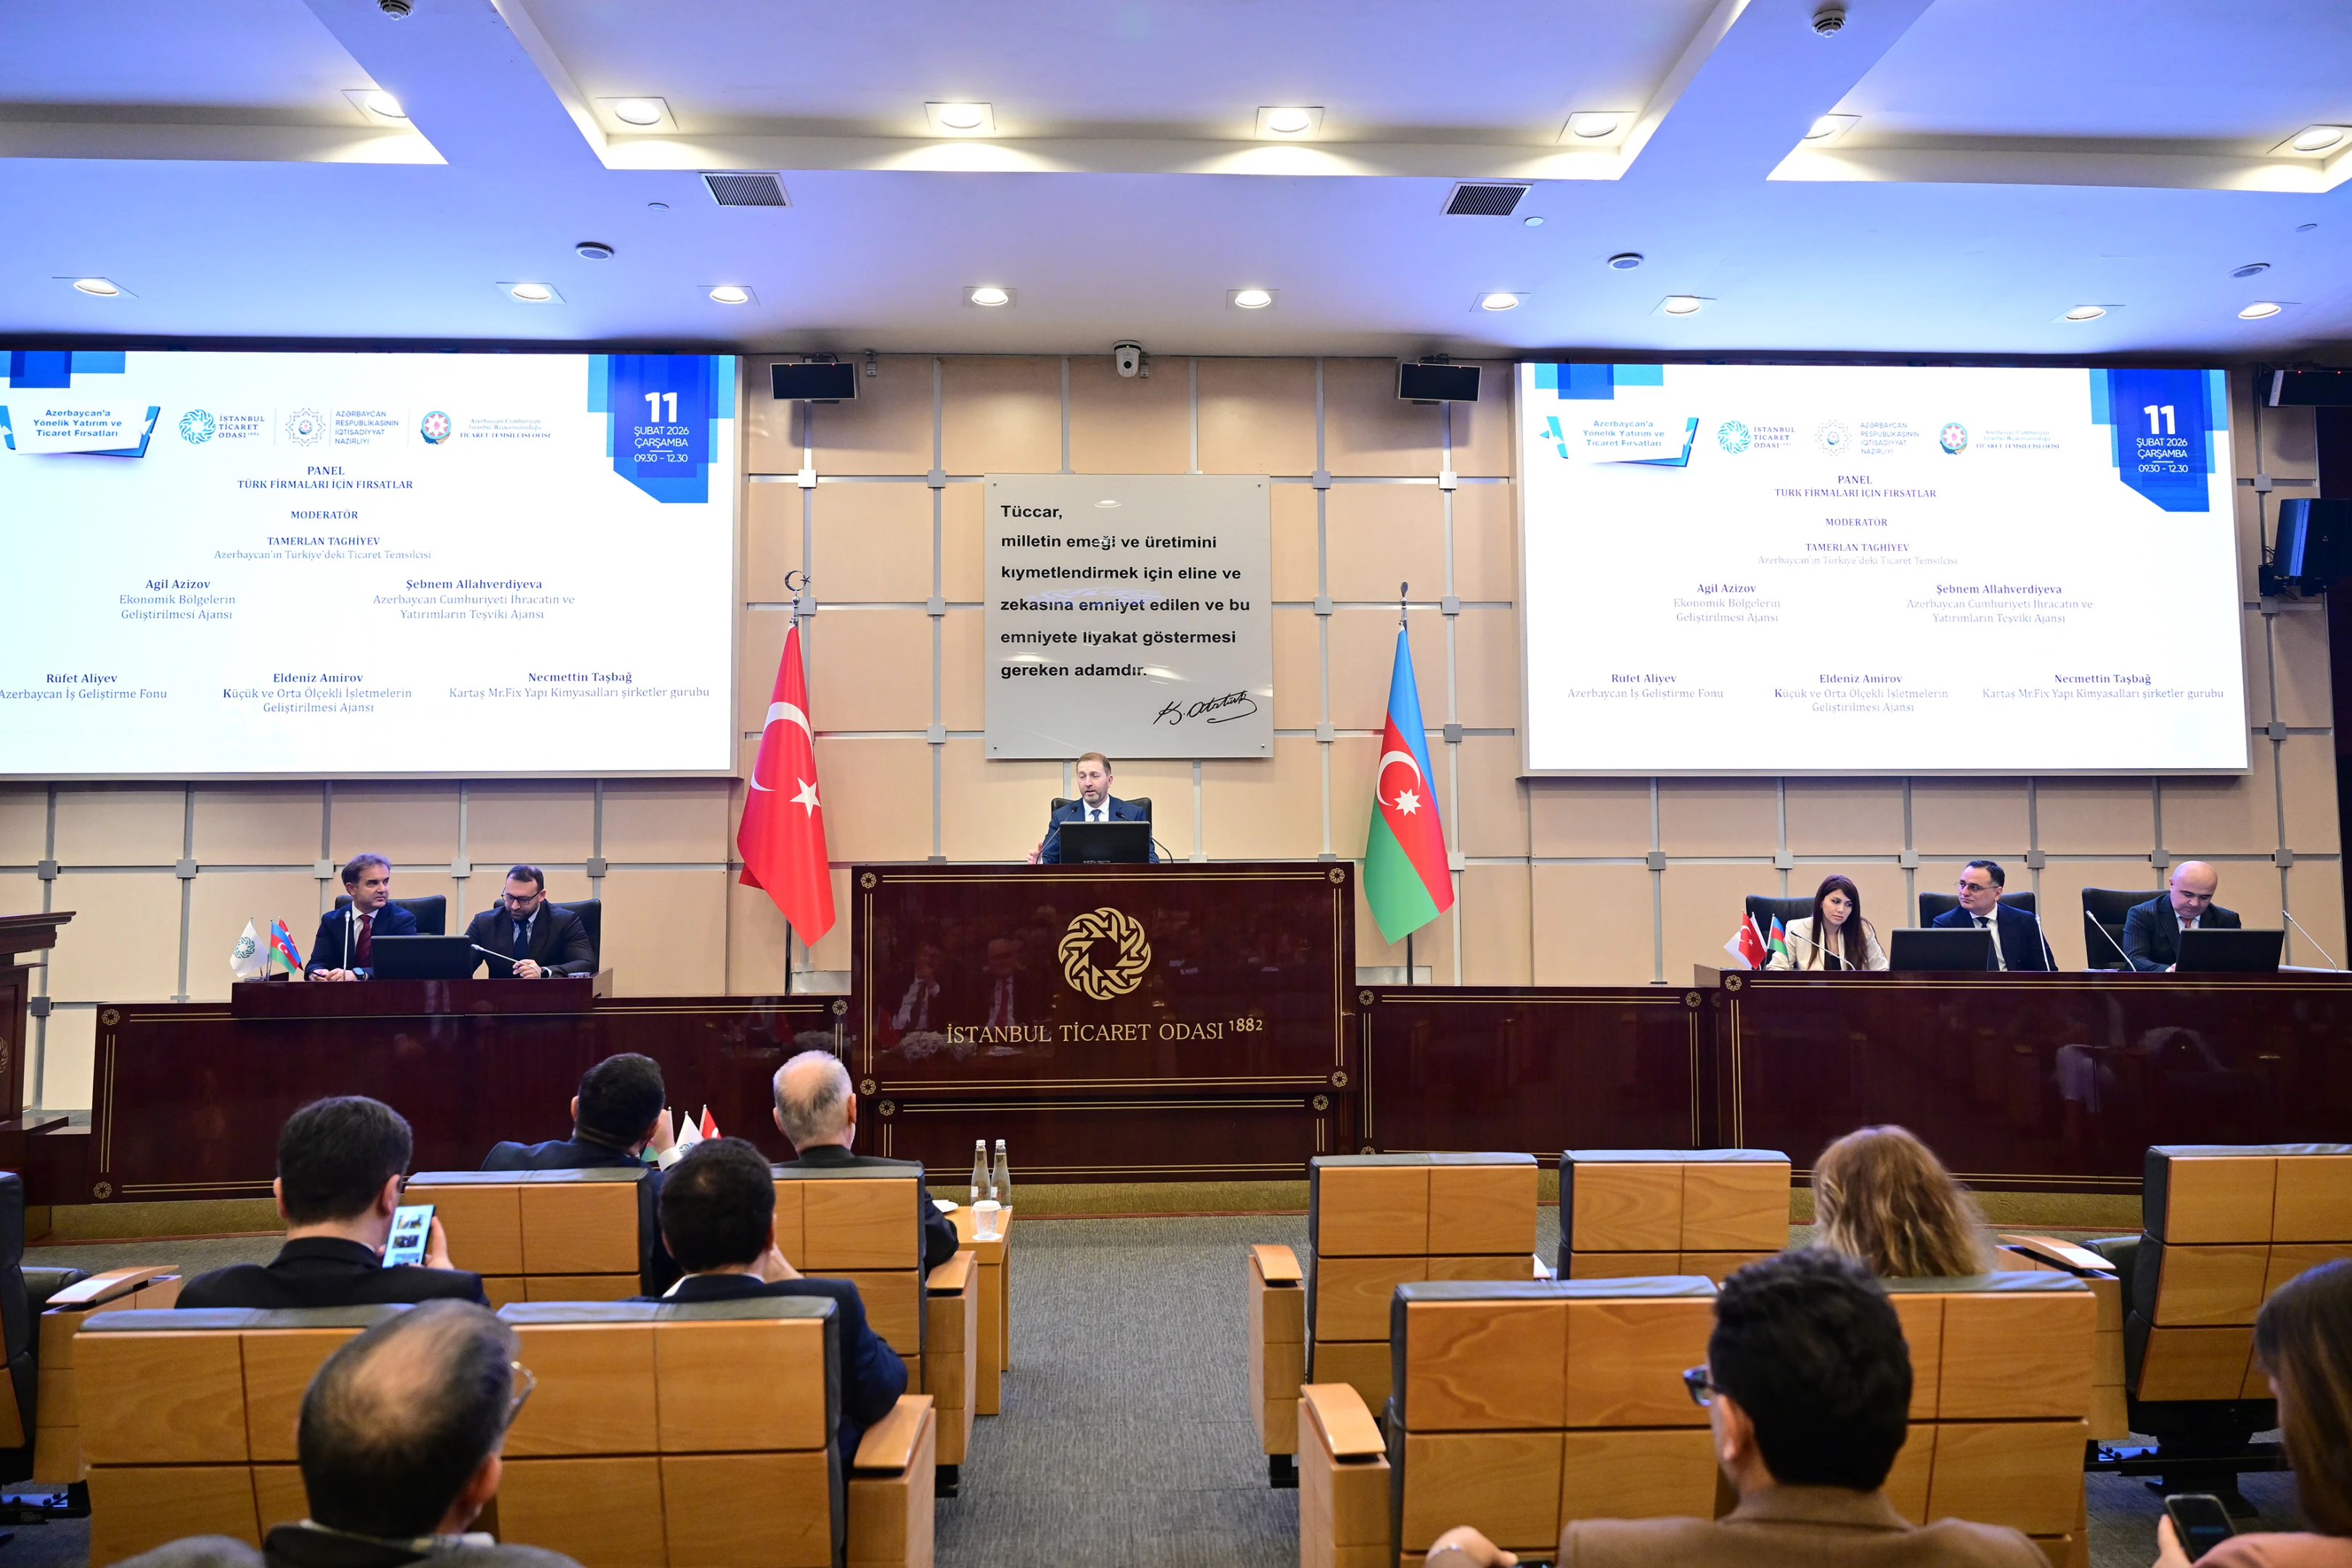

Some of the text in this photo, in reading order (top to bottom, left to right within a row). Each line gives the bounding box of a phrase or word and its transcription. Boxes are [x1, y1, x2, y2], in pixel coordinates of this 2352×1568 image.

[645, 392, 677, 422] 11
[2144, 405, 2176, 435] 11
[634, 426, 690, 437] ŞUBAT 2026
[634, 438, 689, 449] ÇARŞAMBA
[2136, 437, 2188, 449] ŞUBAT 2026
[634, 454, 658, 462] 09.30
[666, 454, 688, 462] 12.30
[2137, 449, 2188, 460] ÇARŞAMBA
[308, 466, 345, 475] PANEL
[2138, 464, 2160, 473] 09.30
[237, 478, 267, 489] TÜRK
[270, 478, 328, 489] FİRMALARI
[332, 478, 353, 491] İÇİN
[1838, 475, 1872, 484] PANEL
[1774, 487, 1802, 497] TÜRK
[1805, 487, 1858, 497] FİRMALARI
[1861, 488, 1881, 498] İÇİN
[291, 509, 358, 519] MODERATÖR
[1000, 505, 1062, 520] Tüccar,
[1826, 517, 1887, 526] MODERATÖR
[327, 535, 380, 545] TAGHİYEV
[1002, 534, 1216, 550] milletin emeği ve üretimini
[1805, 542, 1909, 552] TAMERLAN TAGHİYEV
[347, 550, 381, 559] Ticaret
[384, 550, 431, 559] Temsilcisi
[1002, 565, 1241, 582] kıymetlendirmek için eline ve
[145, 579, 211, 592] Agil Azizov
[407, 579, 542, 591] Şebnem Allahverdiyeva
[1697, 584, 1756, 595] Agil Azizov
[1937, 584, 2062, 596] Şebnem Allahverdiyeva
[120, 594, 235, 607] Ekonomik Bölgelerin
[373, 595, 436, 605] Azerbaycan
[439, 594, 507, 605] Cumhuriyeti
[1674, 598, 1780, 610] Ekonomik Bölgelerin
[1907, 599, 1965, 611] Azerbaycan
[1000, 598, 1249, 614] zekasına emniyet edilen ve bu
[121, 609, 232, 621] Geliştirilmesi Ajansı
[401, 609, 544, 621] Yatırımların Teşviki Ajansı
[1747, 613, 1779, 624] Ajansı
[1996, 613, 2031, 624] Teşviki
[2034, 613, 2065, 624] Ajansı
[1000, 631, 1236, 646] emniyete liyakat göstermesi
[1001, 663, 1147, 679] gereken adamdır.
[46, 674, 118, 685] Rüfet Aliyev
[274, 673, 363, 682] Eldeniz Amirov
[528, 672, 632, 684] Necmettin Taşbağ
[1612, 674, 1677, 685] Rüfet Aliyev
[1820, 674, 1902, 683] Eldeniz Amirov
[2054, 674, 2152, 685] Necmettin Taşbağ
[78, 688, 136, 701] Geliştirme
[139, 688, 167, 698] Fonu
[223, 688, 258, 701] Küçük
[277, 688, 301, 698] Orta
[304, 686, 342, 700] Ölçekli
[450, 687, 709, 700] Kartaş Mr.Fix Yapı Kimyasalları şirketler gurubu
[1568, 688, 1628, 701] Azerbaycan
[1642, 688, 1695, 700] Geliştirme
[1699, 688, 1723, 698] Fonu
[1774, 688, 1808, 700] Küçük
[1824, 688, 1847, 698] Orta
[1983, 688, 2224, 701] Kartaş Mr.Fix Yapı Kimyasalları şirketler gurubu
[263, 702, 373, 714] Geliştirilmesi Ajansı
[1882, 703, 1914, 713] Ajansı
[947, 1018, 1262, 1044] İSTANBUL TİCARET ODASI 1882
